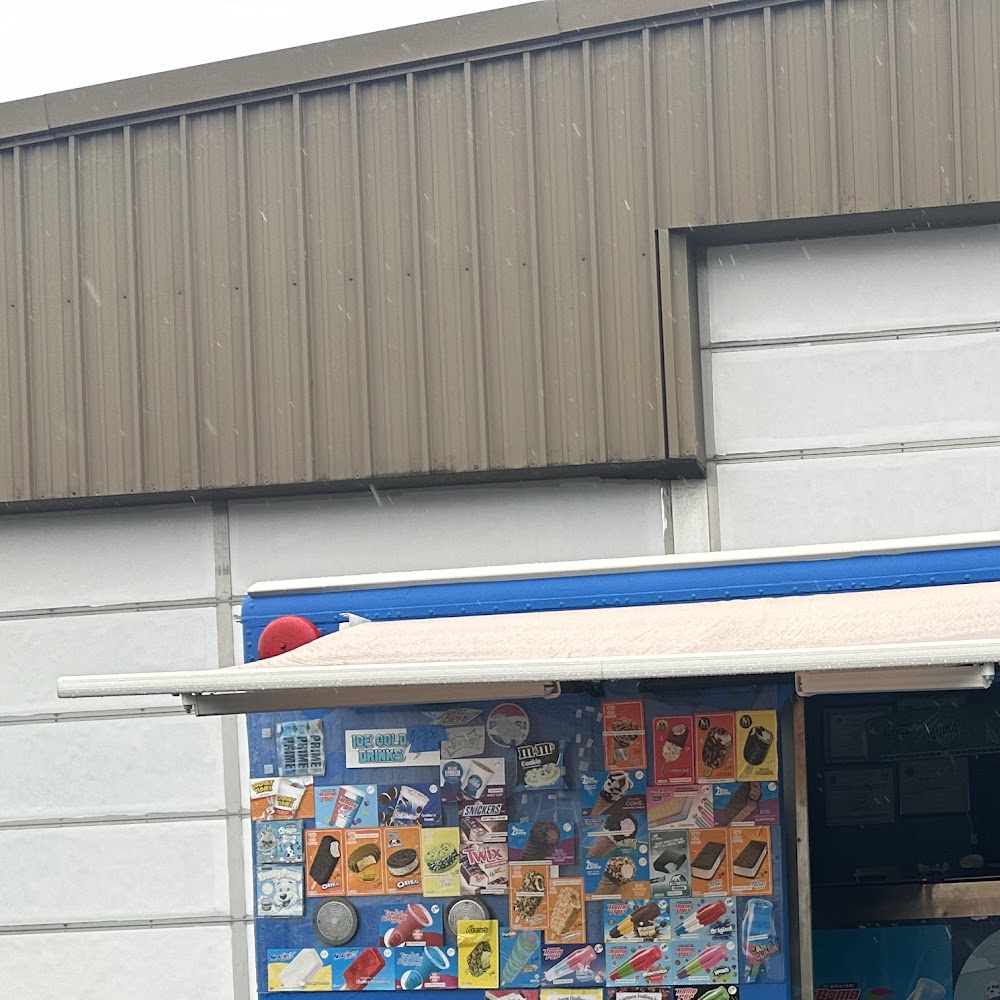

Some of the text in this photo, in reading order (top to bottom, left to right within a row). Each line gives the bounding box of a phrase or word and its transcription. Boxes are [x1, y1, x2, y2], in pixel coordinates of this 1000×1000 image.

[351, 732, 407, 749] ICE COLD
[296, 736, 309, 769] PRIME
[310, 735, 322, 768] PRIME
[358, 748, 406, 763] DRINKS
[464, 804, 501, 816] SNICKERS
